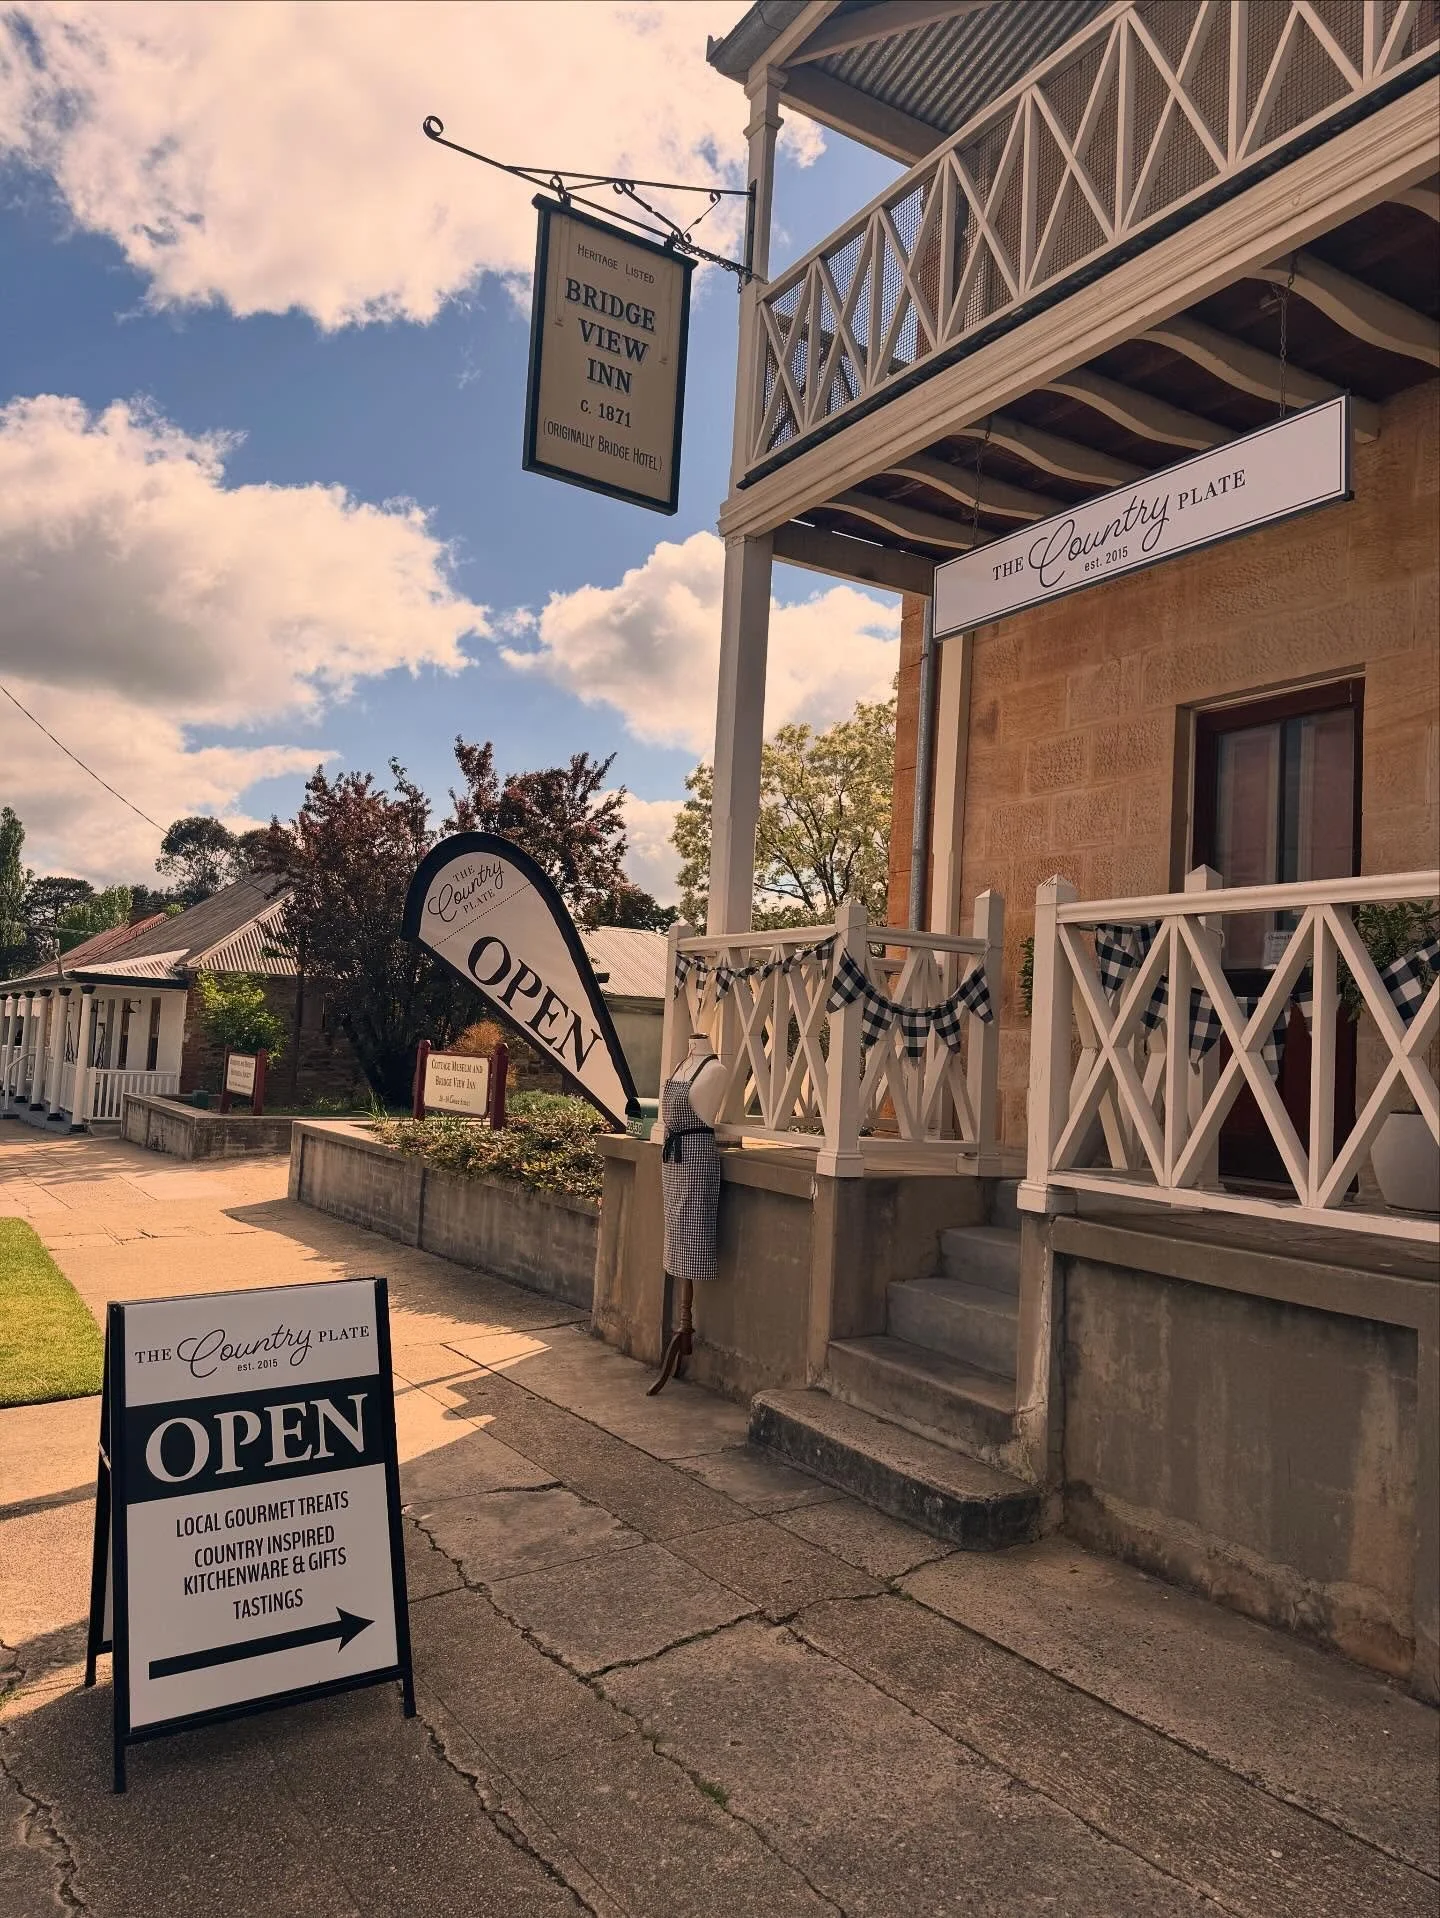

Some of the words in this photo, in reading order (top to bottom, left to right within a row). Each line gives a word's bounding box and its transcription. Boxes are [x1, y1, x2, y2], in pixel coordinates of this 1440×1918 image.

[577, 243, 618, 270] HERITAGE
[625, 263, 655, 285] LISTED
[565, 277, 656, 333] BRIDGE
[577, 317, 649, 363] VIEW
[587, 357, 632, 394] INN
[598, 402, 632, 428] 1871
[543, 416, 595, 450] (ORIGINALLY
[598, 434, 631, 461] BRIDGE
[632, 447, 664, 472] HOTEL)
[992, 556, 1025, 582] THE
[1028, 494, 1171, 589] Country
[1177, 469, 1247, 511] PLATE
[1084, 554, 1102, 573] est.
[1105, 546, 1129, 568] 2015
[427, 860, 505, 923] Country
[452, 863, 476, 883] THE
[462, 888, 496, 915] PLATE
[467, 936, 603, 1073] OPEN
[134, 1348, 172, 1364] THE
[176, 1324, 313, 1378] Country
[318, 1325, 370, 1343] PLATE
[237, 1362, 255, 1372] est.
[257, 1358, 278, 1370] 2015
[145, 1393, 368, 1483] OPEN
[176, 1512, 222, 1538] LOCAL
[224, 1499, 296, 1530] GOURMET
[298, 1490, 350, 1517] TREATS
[194, 1537, 264, 1568] COUNTRY
[266, 1525, 335, 1555] INSPIRED
[183, 1557, 290, 1596] KITCHENWARE
[293, 1555, 305, 1574] &
[308, 1546, 348, 1572] GIFTS
[233, 1588, 304, 1620] TASTINGS
